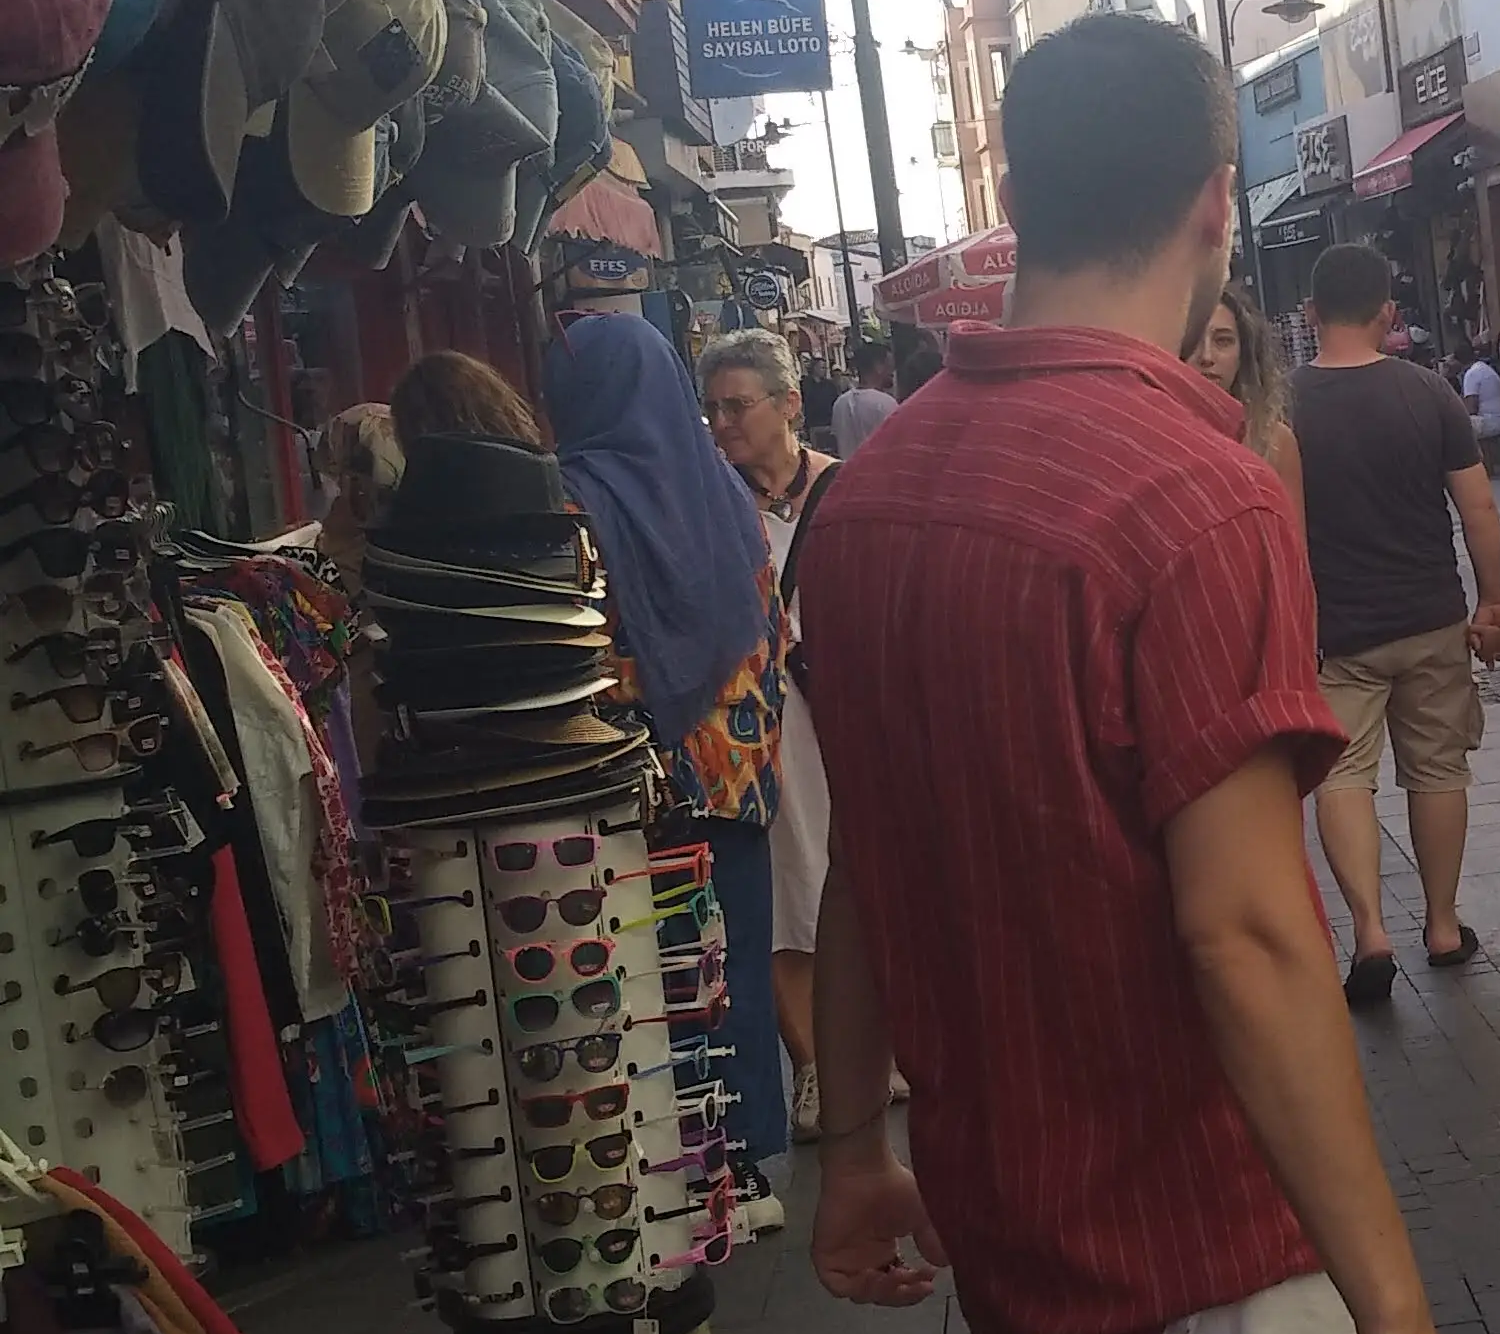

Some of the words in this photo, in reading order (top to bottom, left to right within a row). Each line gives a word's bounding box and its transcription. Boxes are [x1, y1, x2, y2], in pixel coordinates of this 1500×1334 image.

[707, 19, 763, 38] HELEN
[767, 14, 813, 34] BÜFE
[703, 40, 774, 58] SAYISAL
[778, 37, 821, 54] LOTO
[589, 259, 628, 273] EFES
